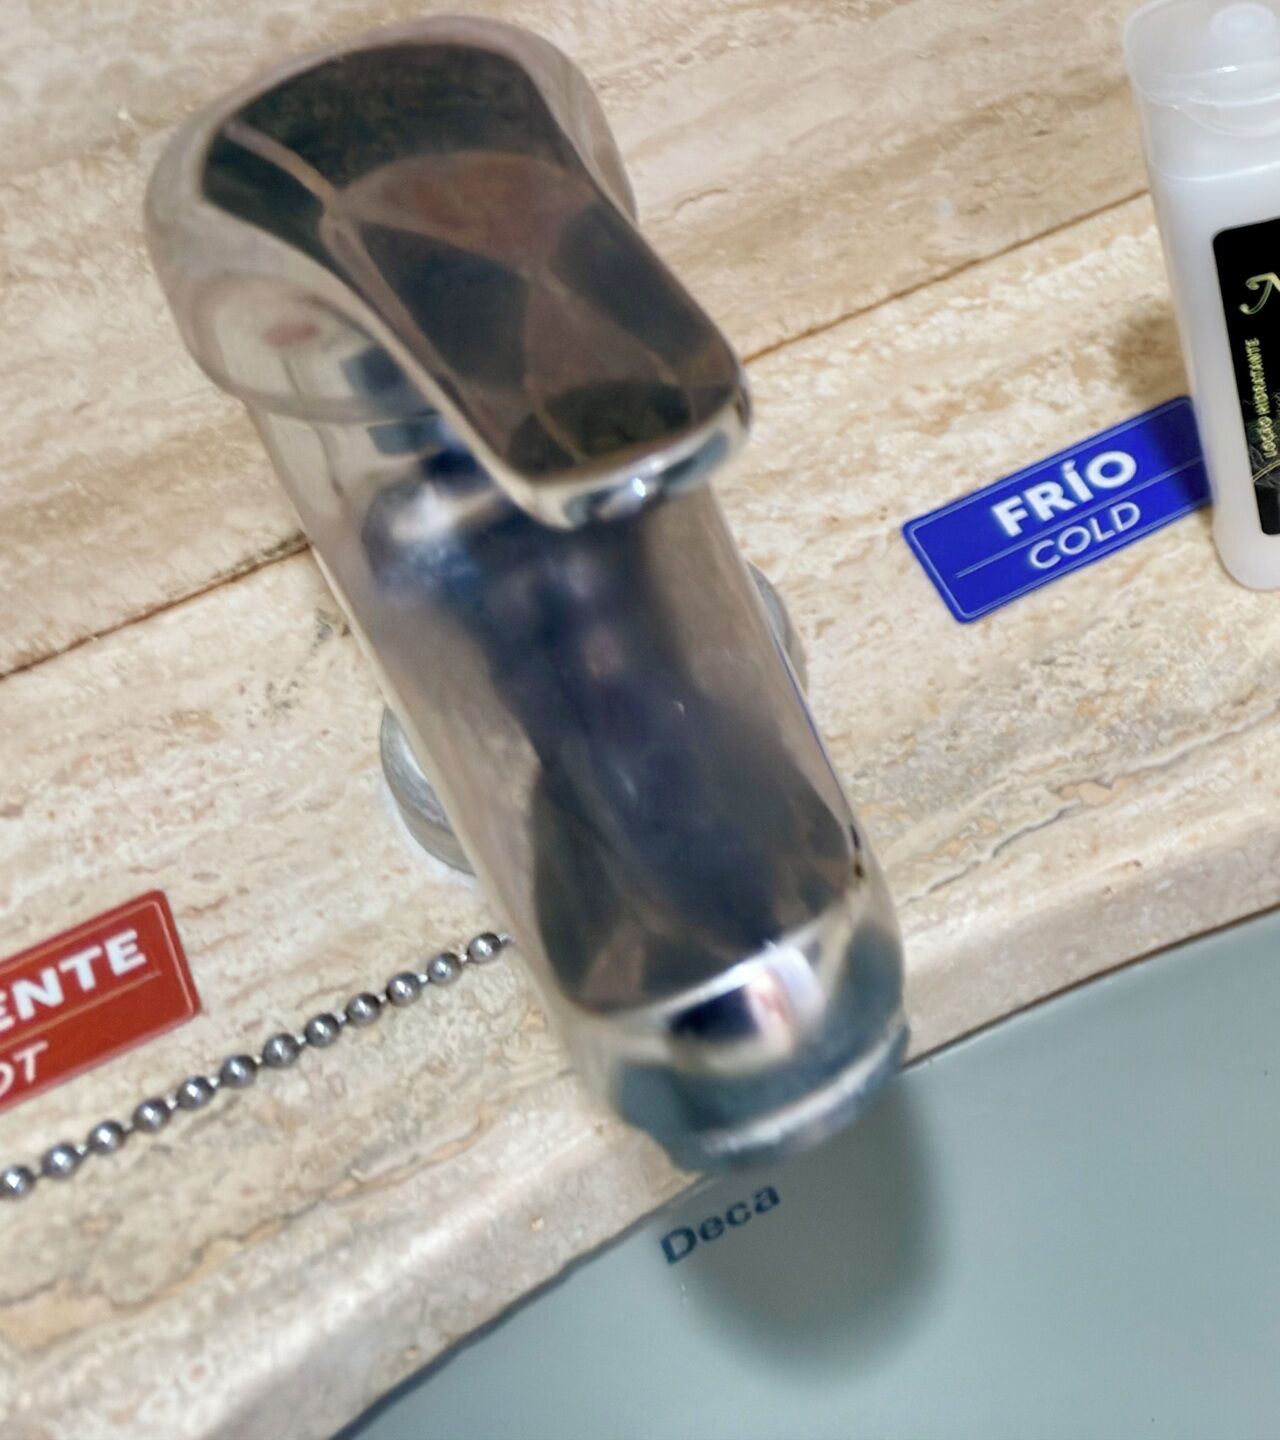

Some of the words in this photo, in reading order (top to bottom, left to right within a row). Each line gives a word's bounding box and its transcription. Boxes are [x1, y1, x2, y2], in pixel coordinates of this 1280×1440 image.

[991, 450, 1138, 538] FRÍO
[1028, 501, 1141, 570] COLD
[660, 1185, 780, 1265] Deca
